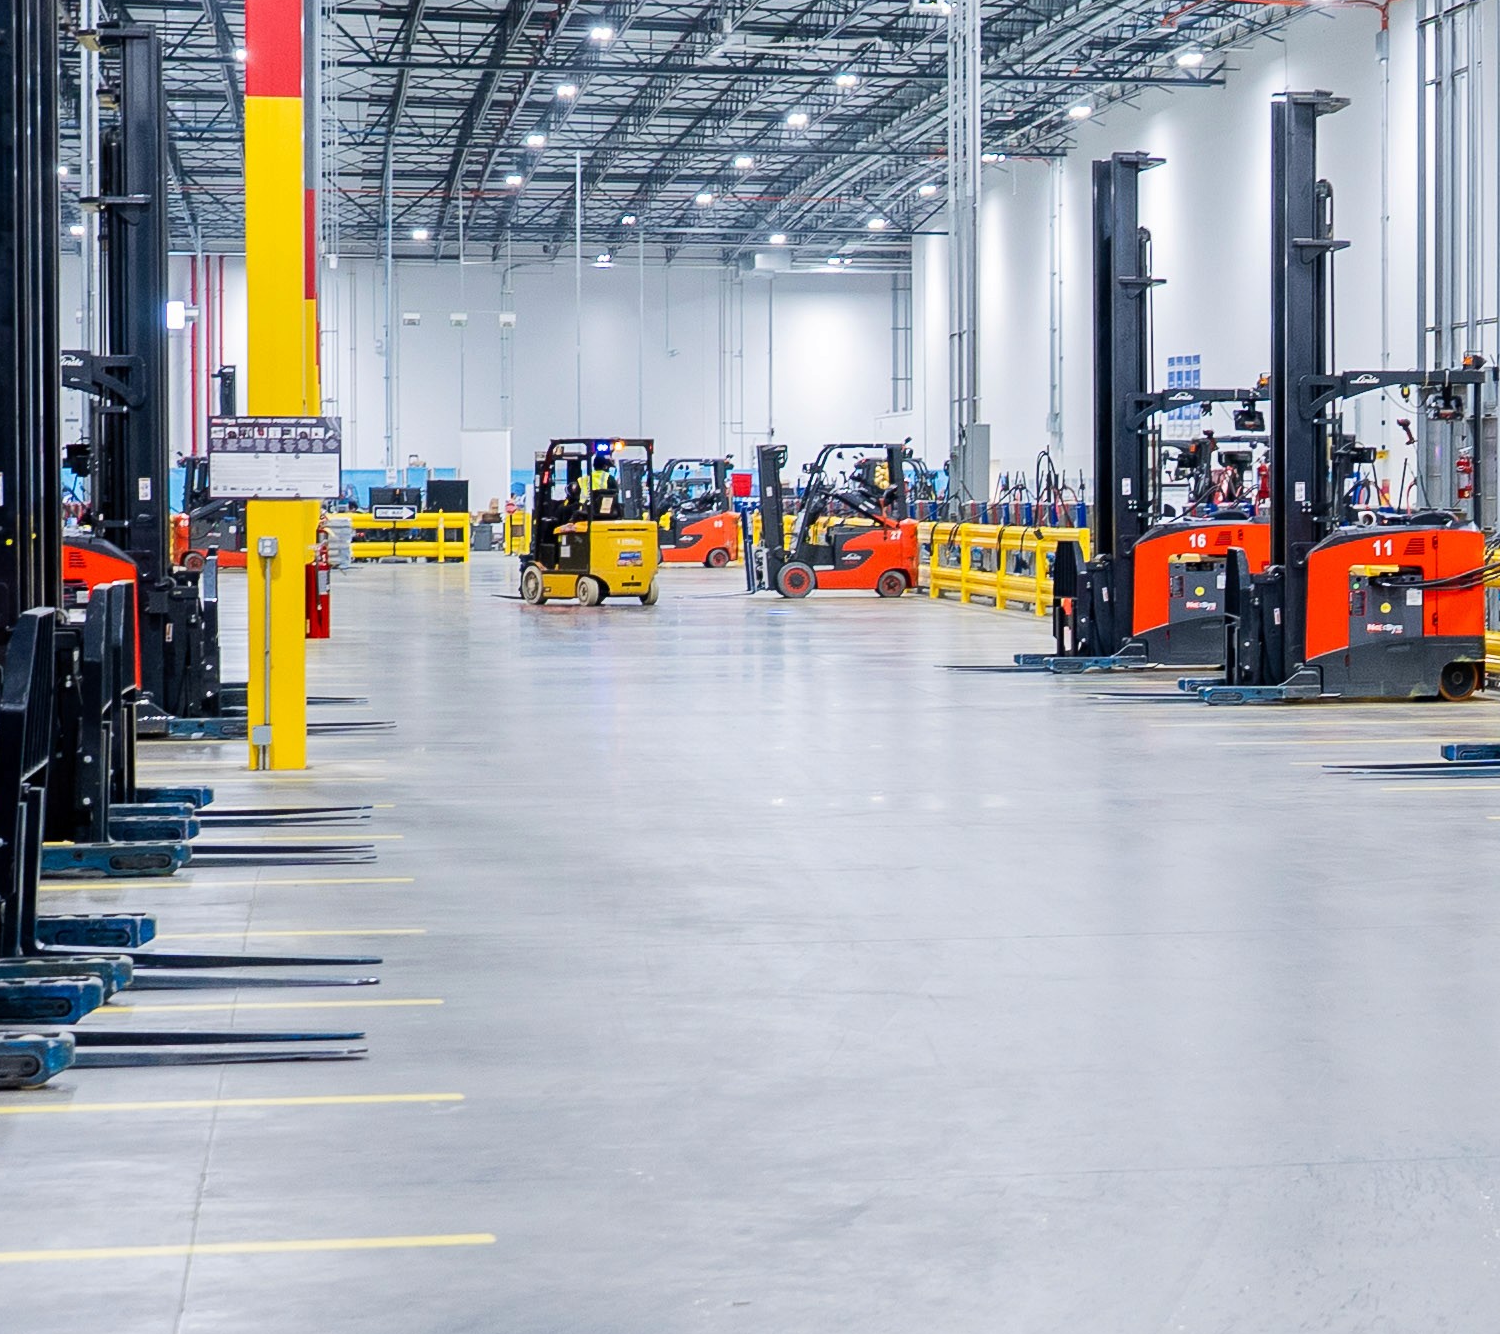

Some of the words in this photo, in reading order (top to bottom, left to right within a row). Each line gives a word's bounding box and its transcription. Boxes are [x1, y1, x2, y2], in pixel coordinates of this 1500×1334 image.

[890, 530, 902, 541] 27
[1188, 533, 1207, 548] 16
[1372, 539, 1393, 556] 11
